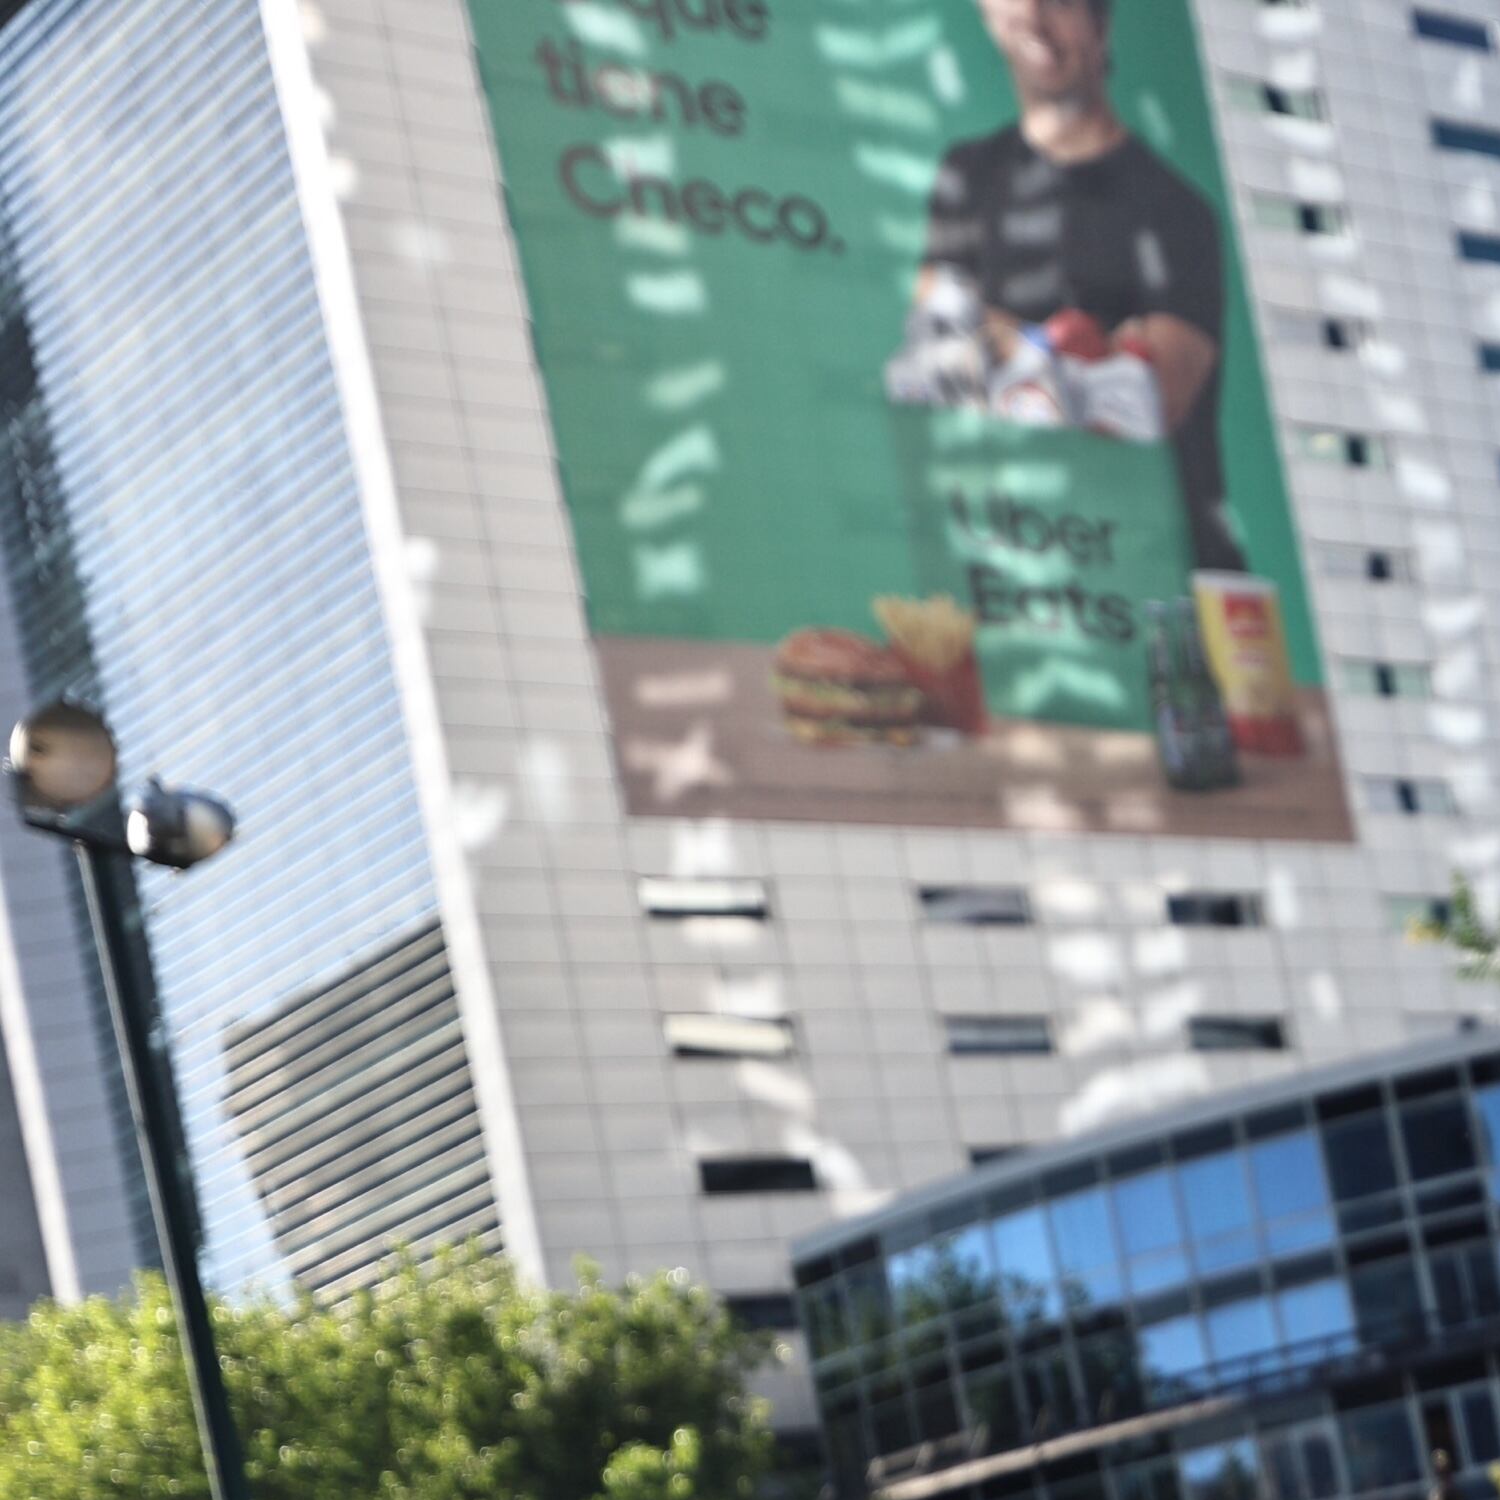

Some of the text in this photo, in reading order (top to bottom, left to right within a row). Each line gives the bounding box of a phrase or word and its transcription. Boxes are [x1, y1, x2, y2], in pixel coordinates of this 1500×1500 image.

[535, 38, 748, 138] tiene
[950, 483, 1118, 568] Uber
[967, 562, 1138, 646] Eats
